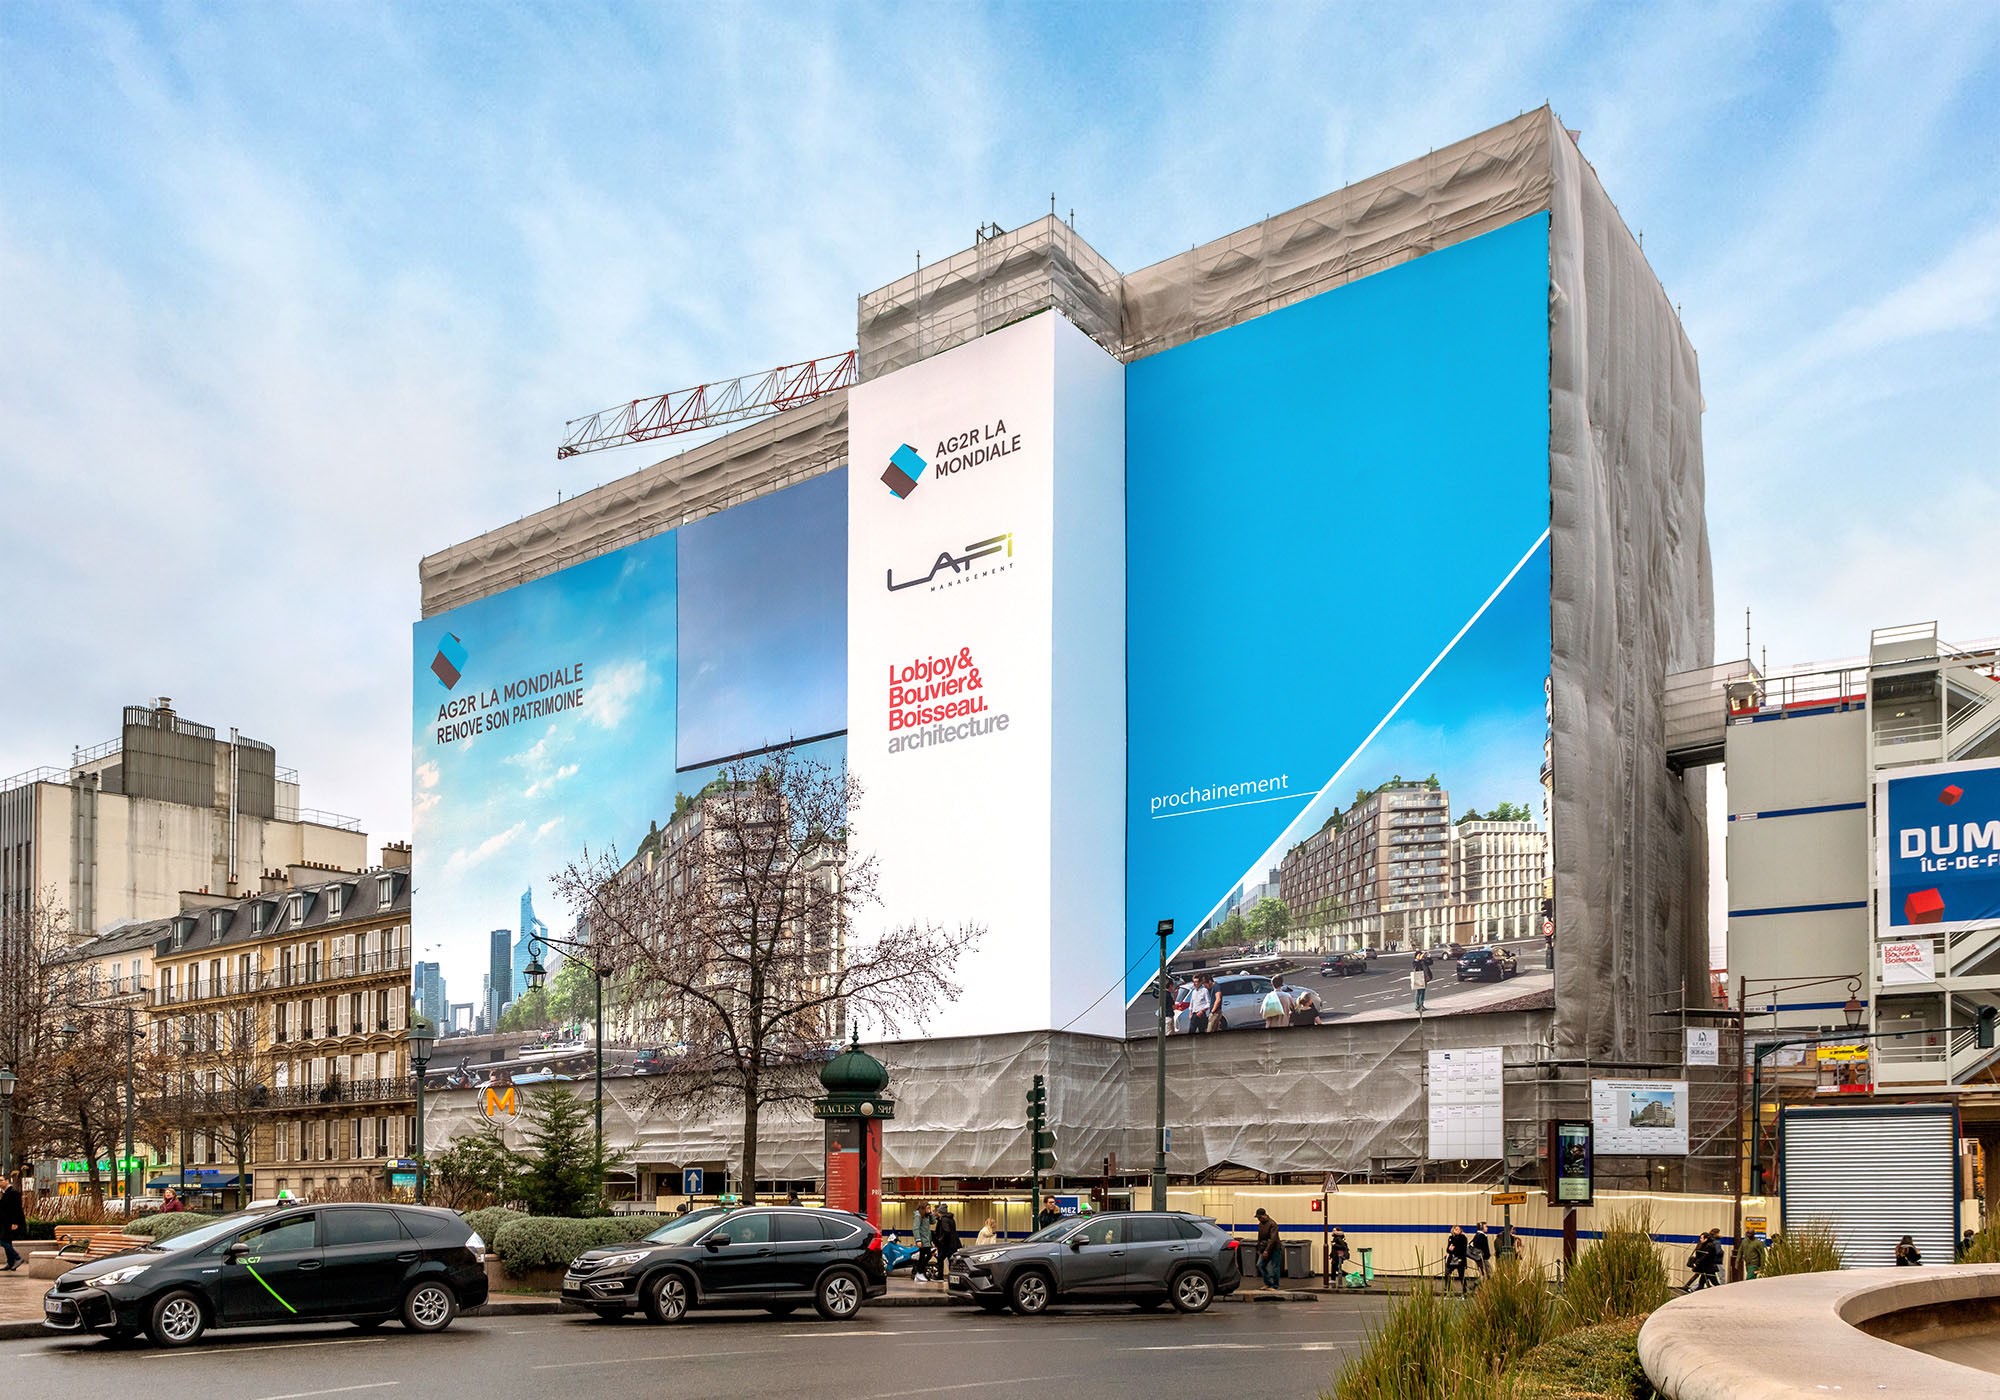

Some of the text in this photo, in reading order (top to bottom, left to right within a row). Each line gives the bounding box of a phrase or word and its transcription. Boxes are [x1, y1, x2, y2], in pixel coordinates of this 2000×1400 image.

[935, 434, 1021, 479] MONDIALE
[936, 419, 1007, 458] AG2R LA
[930, 562, 1014, 593] MANAGEMENT
[889, 646, 974, 686] Lobjoy&
[437, 662, 583, 722] AG2R LA MONDIALE
[889, 668, 983, 709] Bouvier&
[437, 687, 583, 745] RENOVE SON PATRIMOINE
[889, 695, 988, 732] Boisseau.
[888, 713, 1010, 754] architecture
[1151, 774, 1289, 813] prochainement
[1920, 853, 2000, 873] ÎLE-DE-F
[486, 1087, 515, 1117] M
